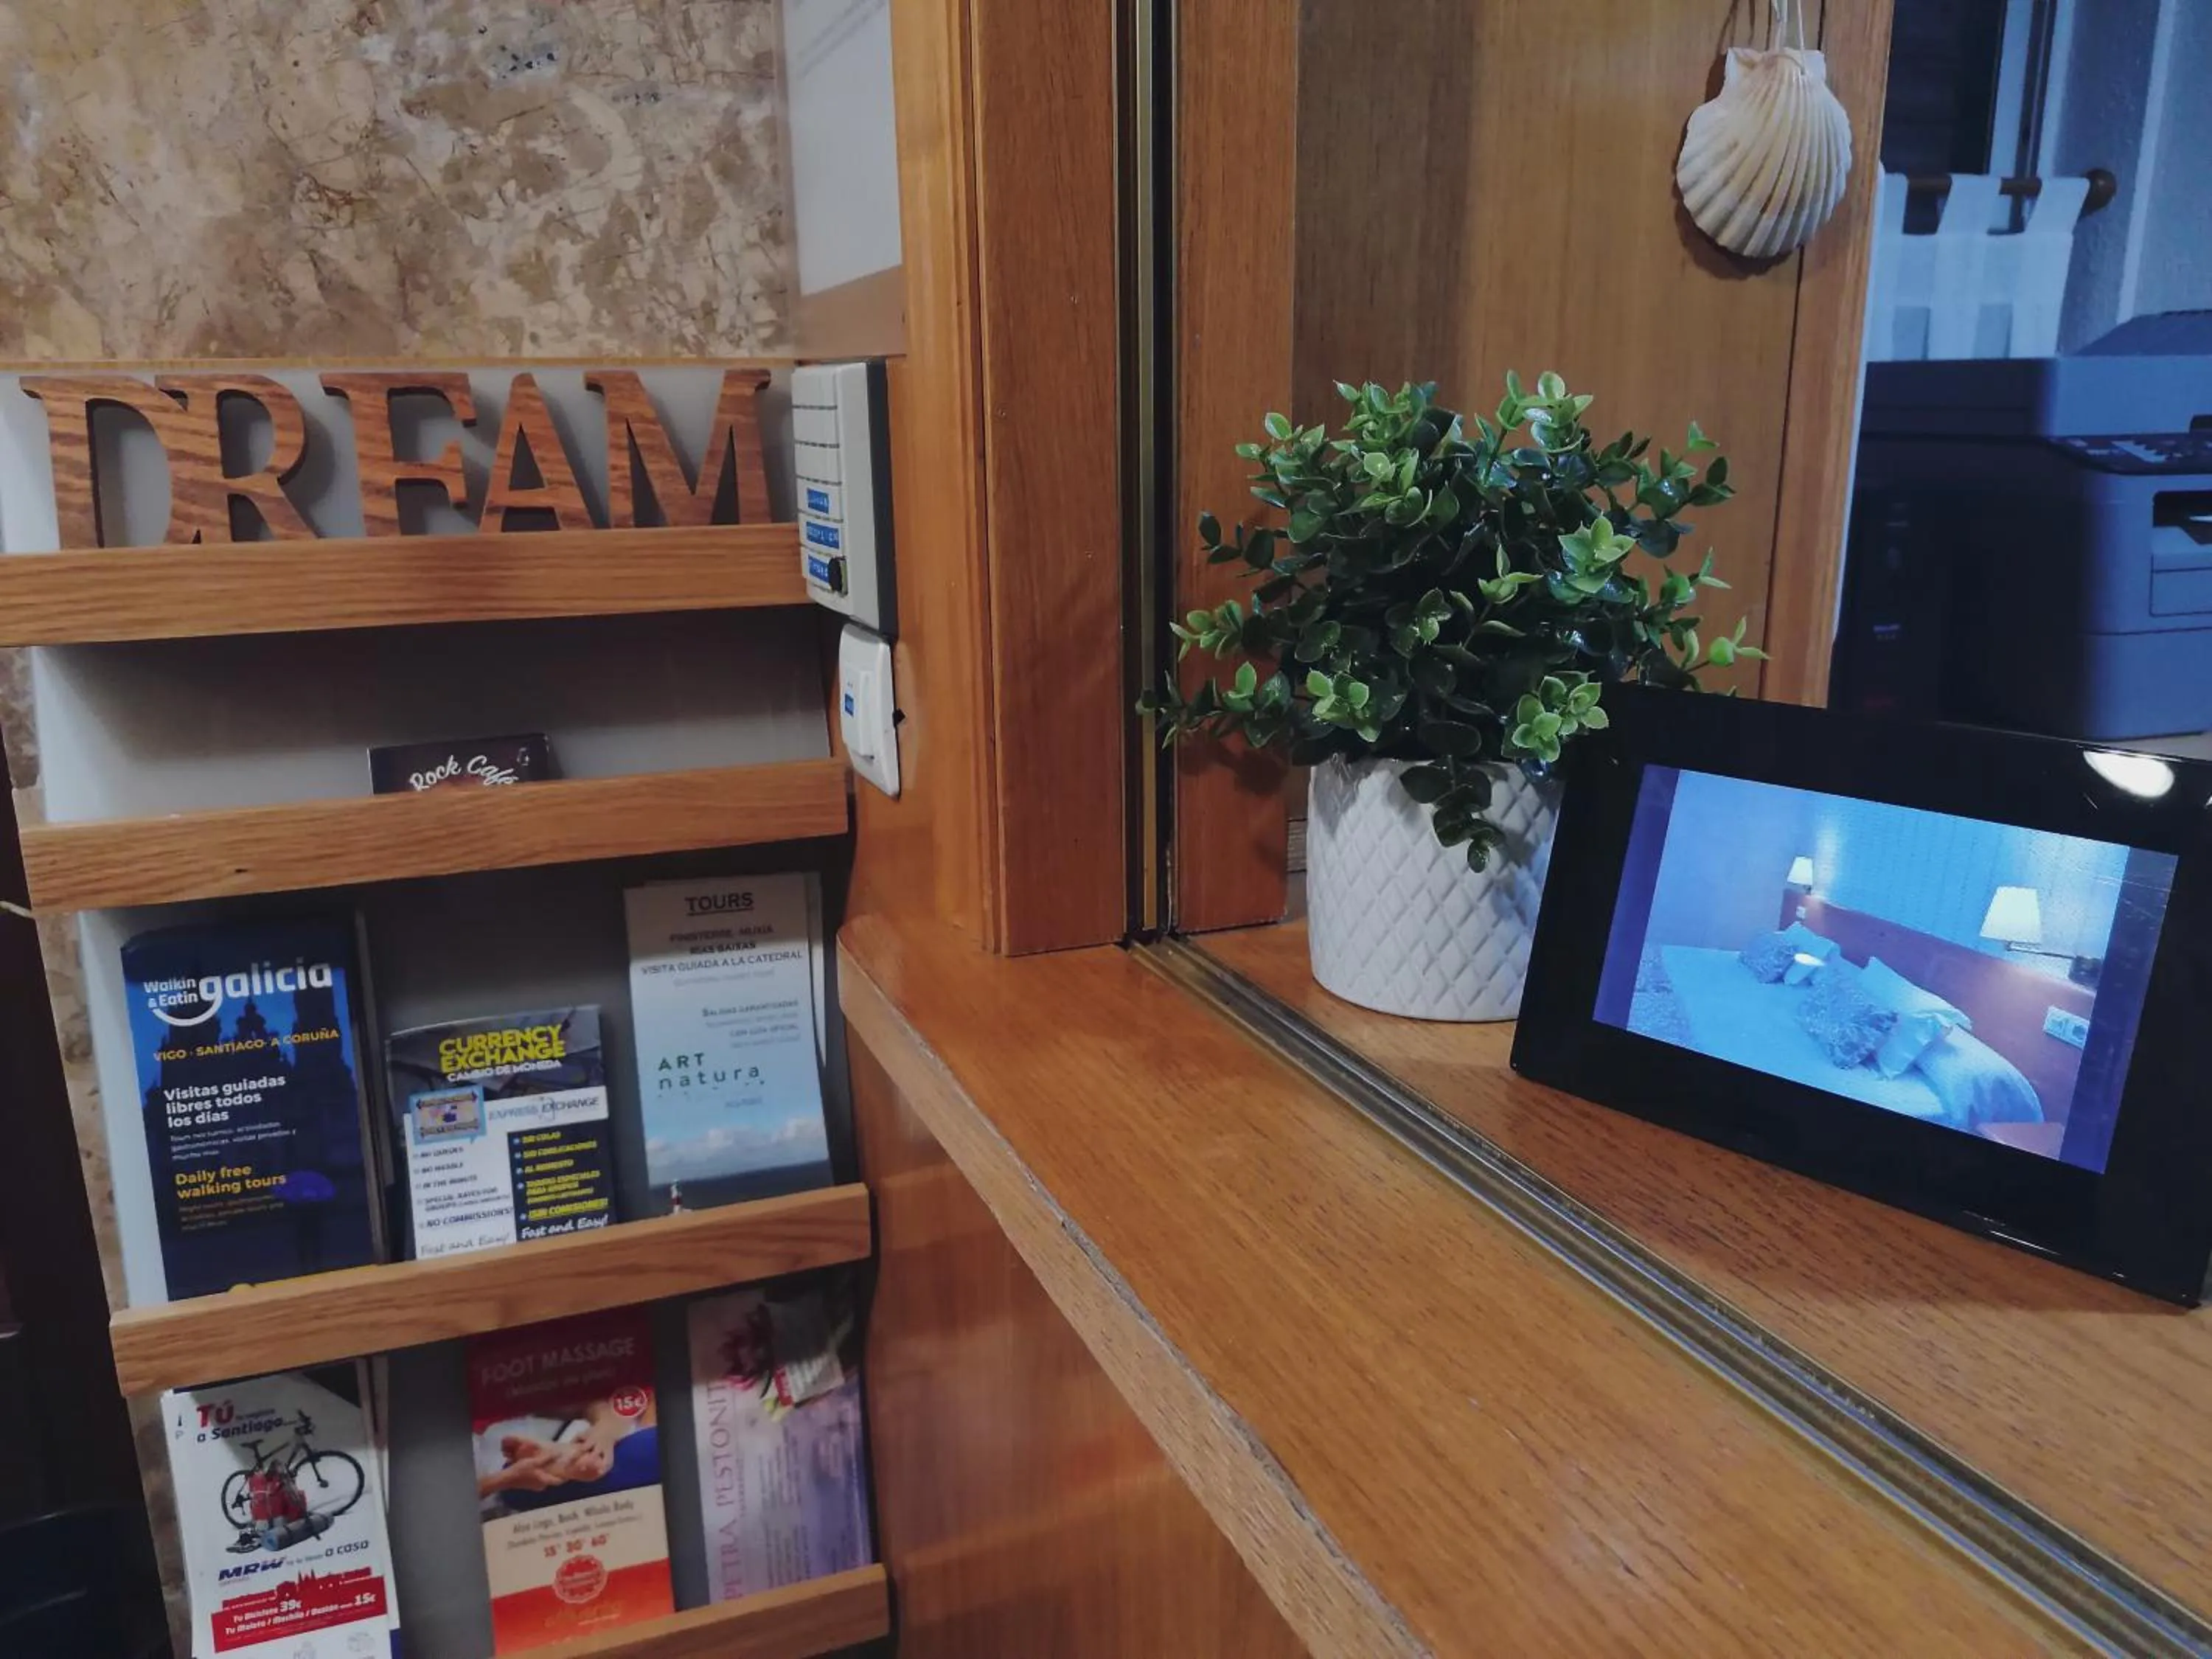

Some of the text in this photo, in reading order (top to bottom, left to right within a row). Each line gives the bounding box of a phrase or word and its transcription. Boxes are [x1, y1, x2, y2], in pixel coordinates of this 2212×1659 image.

[19, 369, 771, 551] DREAM
[409, 754, 462, 791] Rock
[685, 891, 754, 911] TOURS
[641, 950, 802, 975] VISITA GUIADA A LA CATEDRAL
[198, 958, 333, 1010] galicia
[159, 990, 198, 1006] Eatin
[153, 1048, 187, 1062] VIGO
[195, 1040, 265, 1057] SANTIAGO
[283, 1028, 340, 1046] CORUÑA
[439, 1023, 563, 1057] CURRENCY
[440, 1040, 567, 1074] EXCHANGE
[658, 1053, 705, 1071] ART
[164, 1074, 286, 1101] Visitas guiadas
[659, 1066, 760, 1090] natura
[166, 1092, 262, 1115] libres todos
[167, 1114, 192, 1129] los
[175, 1166, 252, 1186] Daily free
[177, 1173, 287, 1200] walking tours
[521, 1225, 547, 1239] Fast
[549, 1219, 574, 1234] and
[481, 1354, 535, 1386] FOOT
[541, 1337, 636, 1368] MASSAGE
[211, 1416, 283, 1440] Santiago
[218, 1559, 285, 1582] MRW
